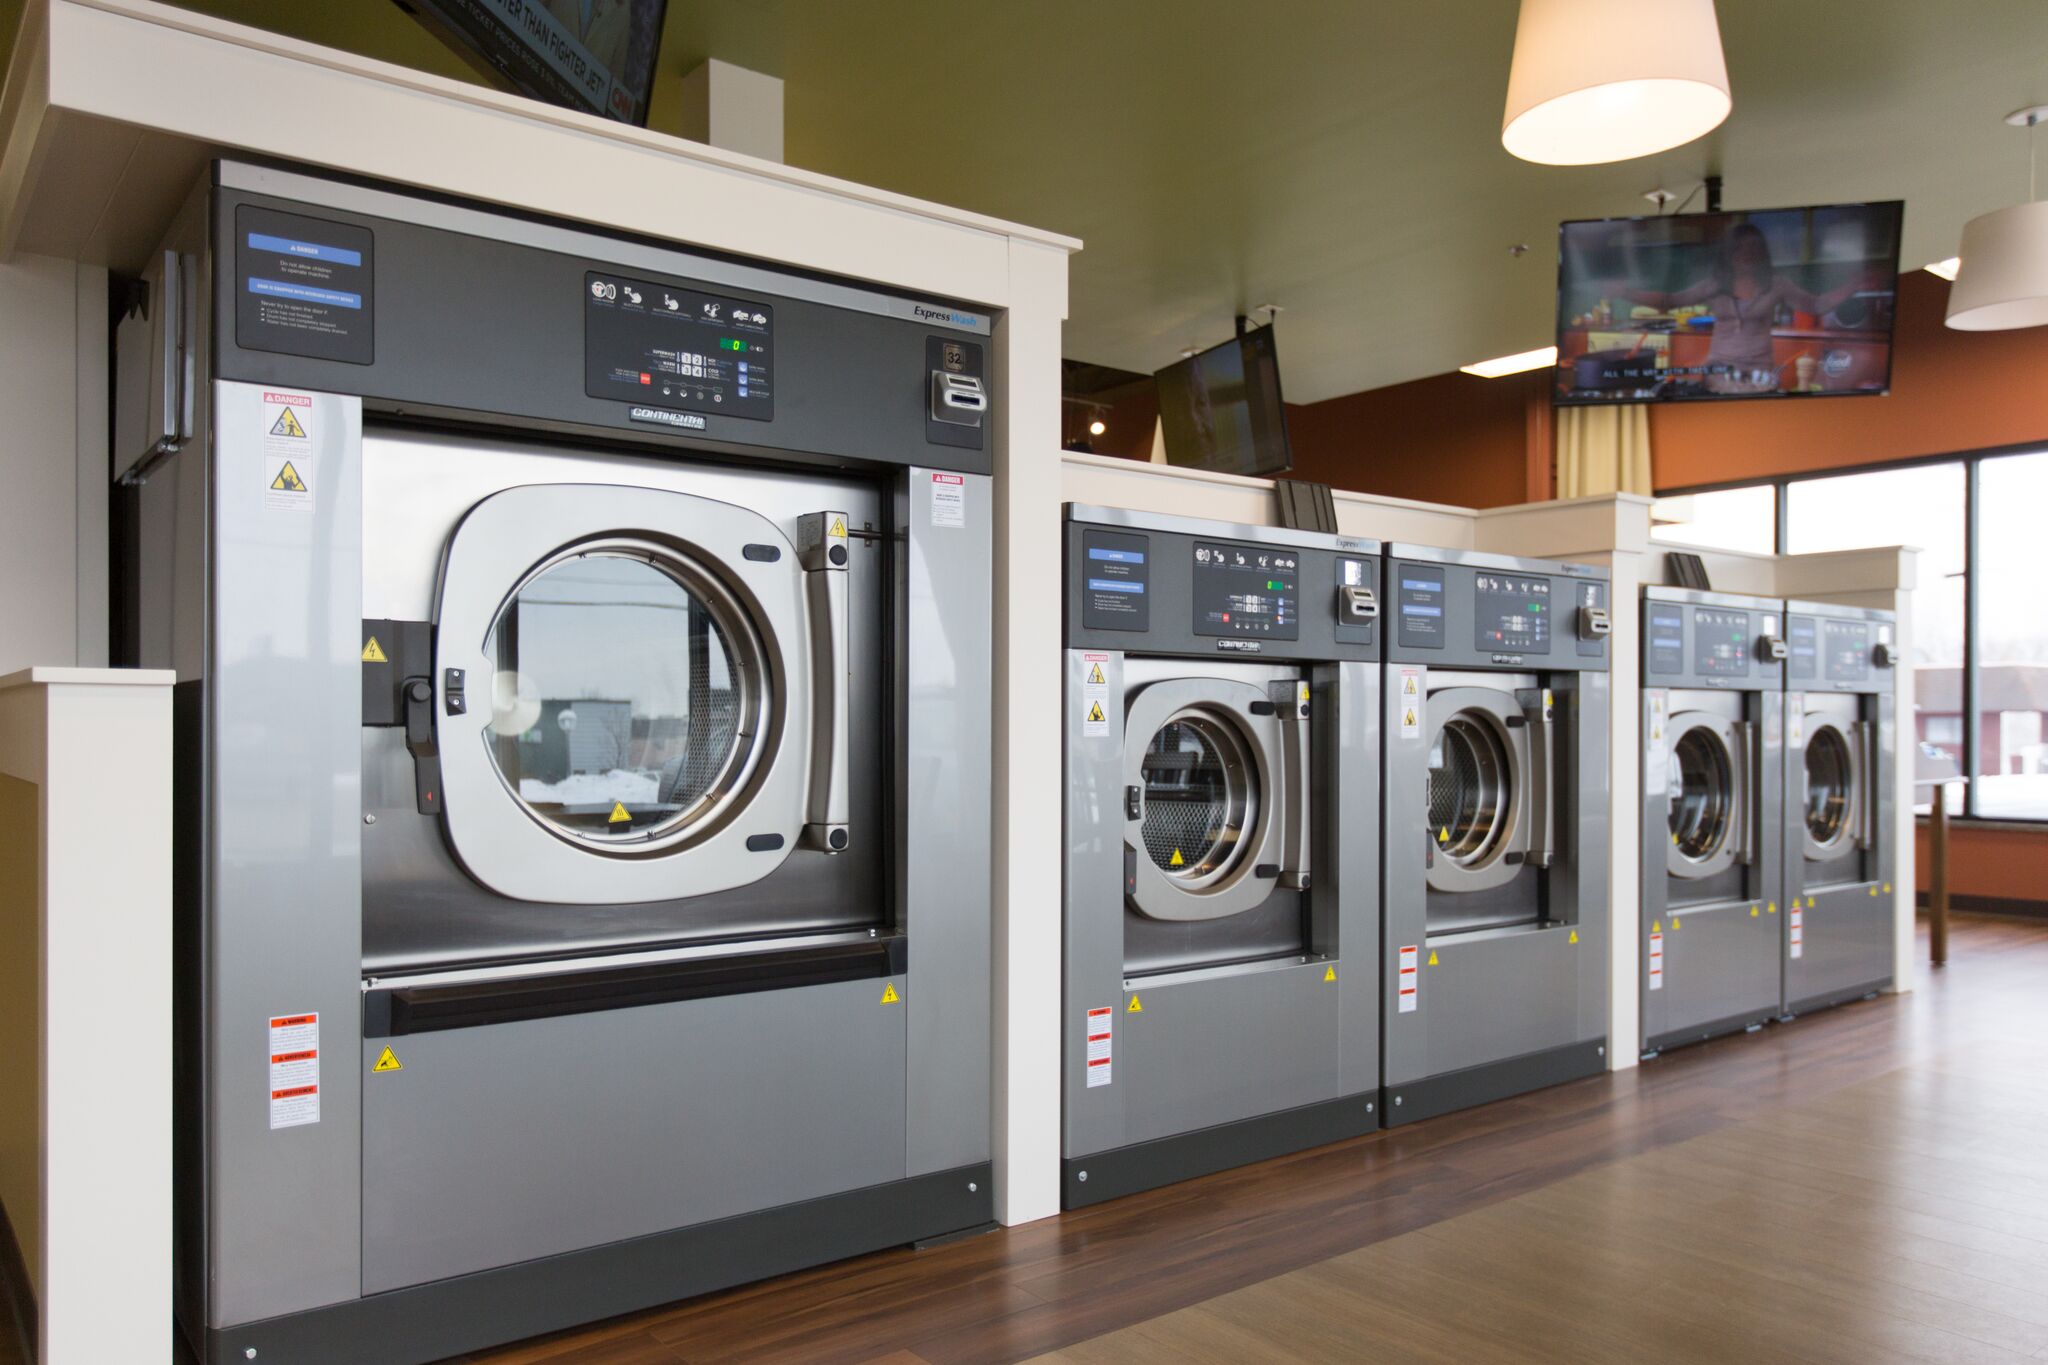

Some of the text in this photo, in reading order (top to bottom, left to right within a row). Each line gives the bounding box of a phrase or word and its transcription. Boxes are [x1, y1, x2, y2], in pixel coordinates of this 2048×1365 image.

[524, 5, 551, 47] THAN
[549, 31, 587, 83] FIGHTER
[612, 87, 633, 116] CNN
[914, 305, 977, 327] ExpressWash
[948, 351, 961, 364] 32
[274, 395, 310, 406] DANGER
